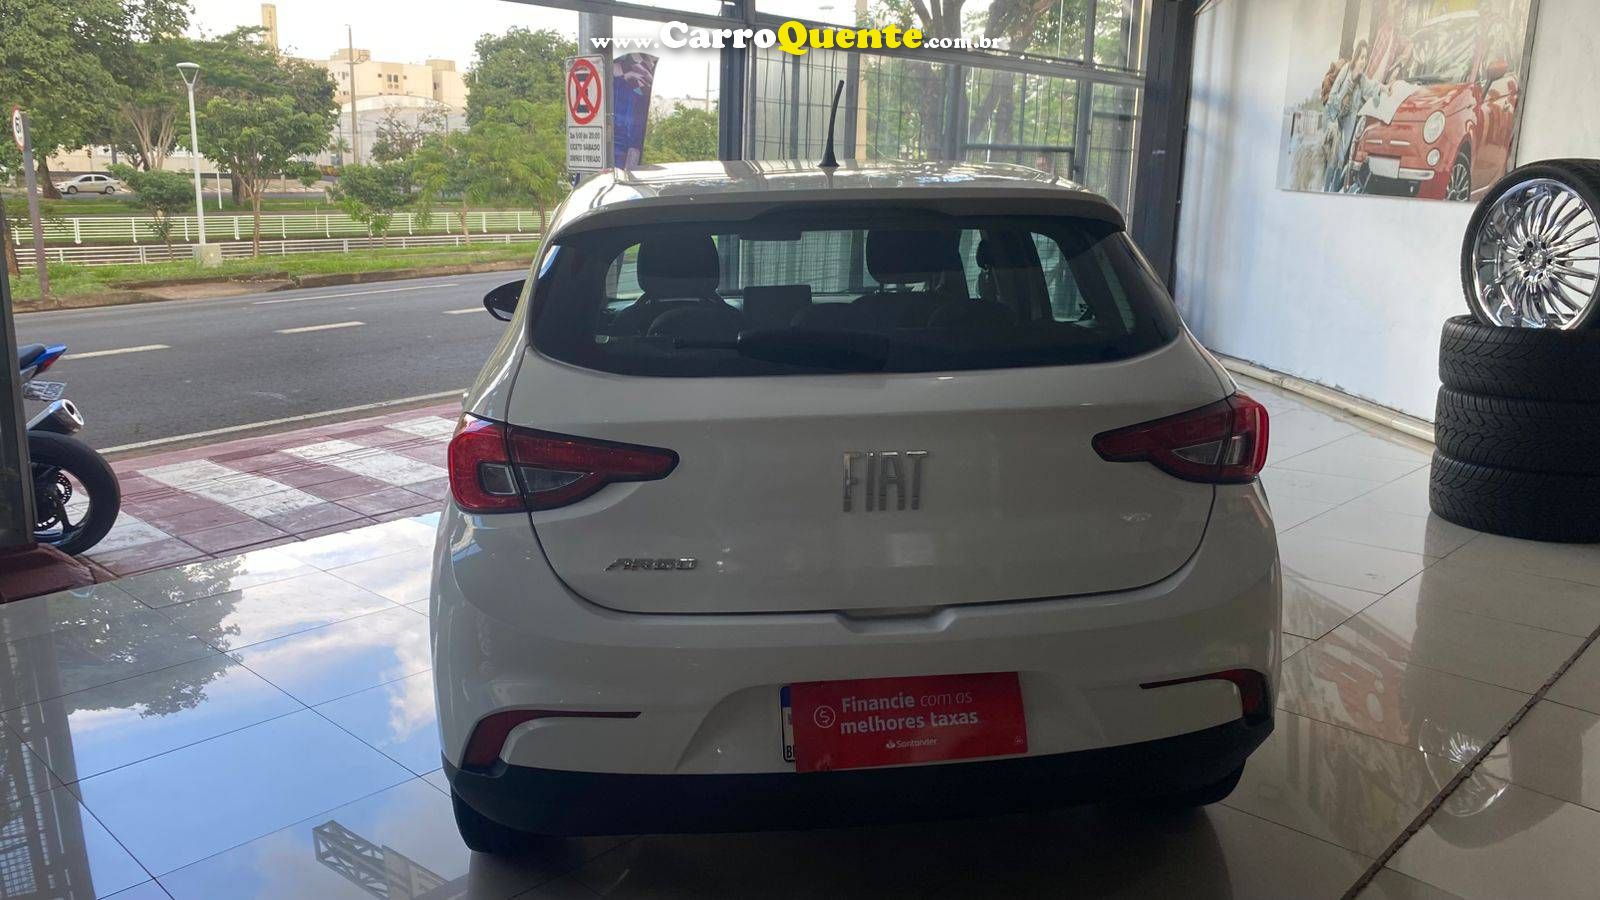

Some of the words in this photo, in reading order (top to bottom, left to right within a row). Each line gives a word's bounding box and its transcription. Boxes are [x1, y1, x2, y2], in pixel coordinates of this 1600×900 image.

[842, 450, 928, 513] FIAT
[604, 557, 698, 571] ARGO
[842, 692, 915, 712] Financie
[920, 693, 951, 707] com
[840, 714, 925, 734] melhores
[930, 711, 978, 727] taxas
[896, 736, 938, 748] Santander
[786, 745, 794, 758] B
